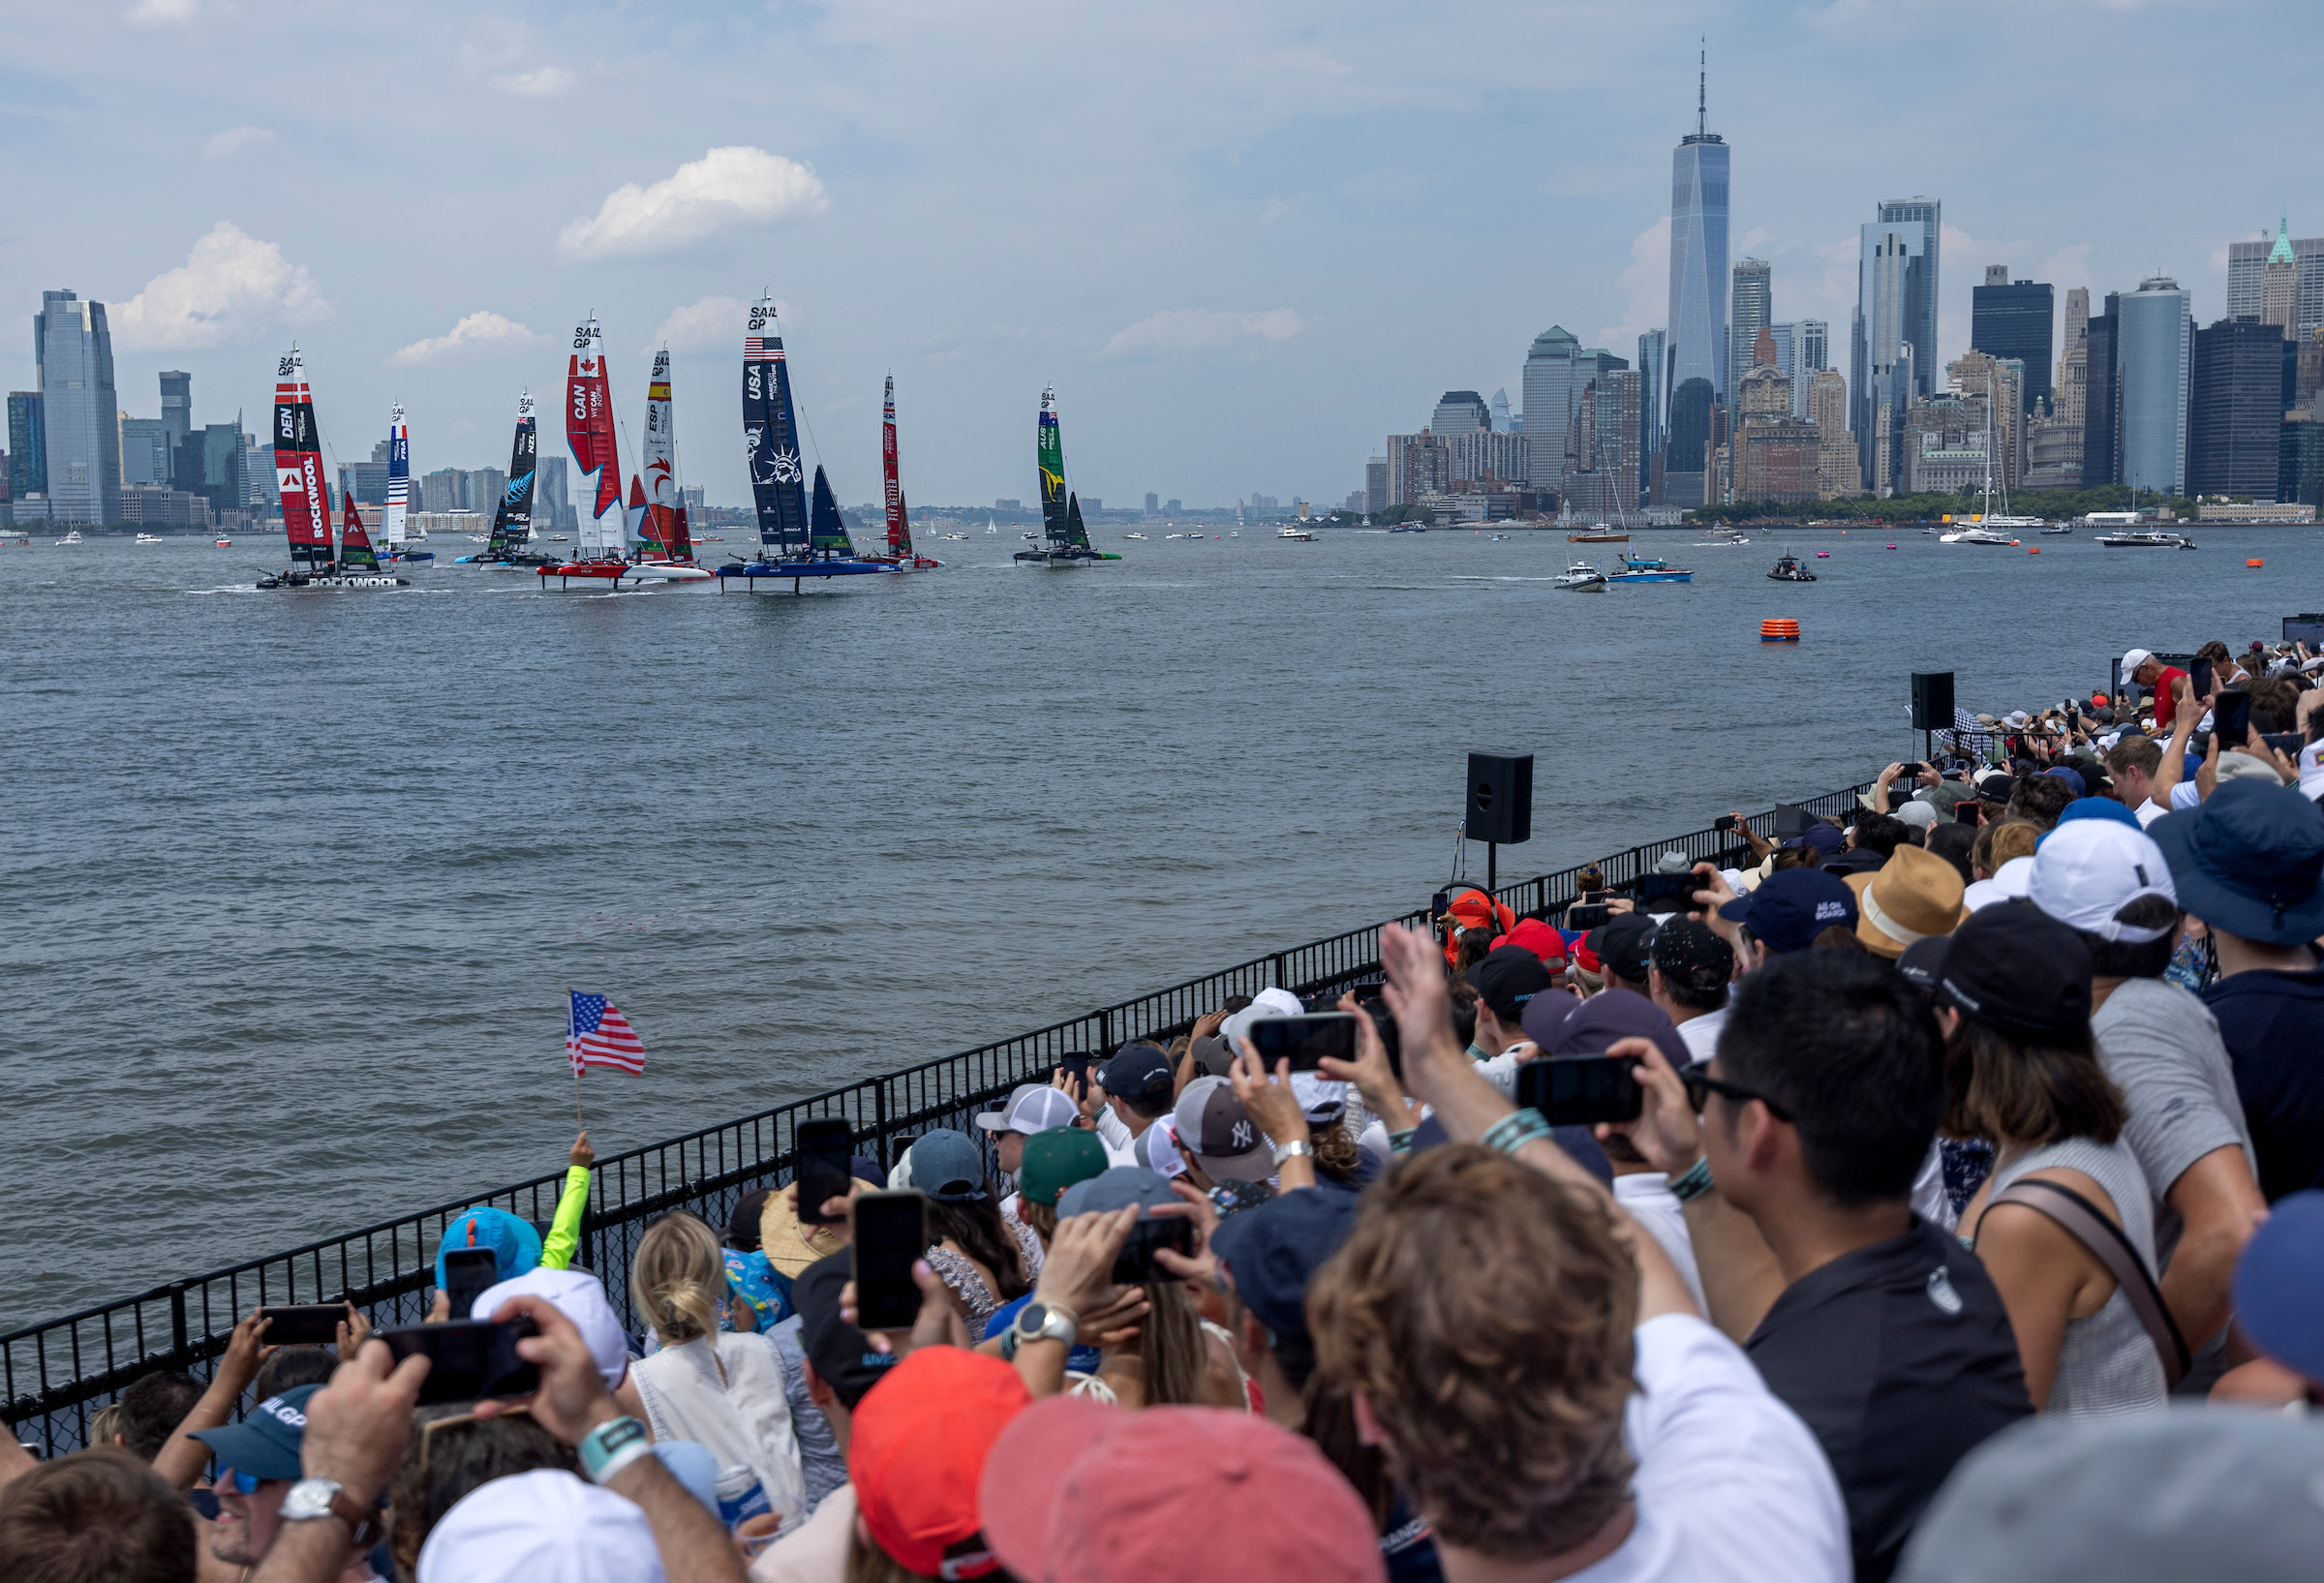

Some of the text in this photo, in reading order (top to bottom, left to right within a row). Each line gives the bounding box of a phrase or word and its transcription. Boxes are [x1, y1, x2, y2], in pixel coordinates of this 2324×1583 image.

[749, 306, 778, 318] SAIL
[748, 319, 766, 330] GP
[574, 326, 601, 338] SAIL
[573, 338, 591, 349] GP
[279, 356, 303, 367] SAIL
[654, 356, 669, 366] SAIL
[278, 366, 294, 377] GP
[652, 367, 664, 377] GP
[748, 364, 761, 401] USA
[573, 384, 587, 419] CAN
[1041, 392, 1055, 401] SAIL
[519, 398, 535, 407] SAIL
[592, 407, 597, 418] WE
[649, 404, 657, 432] ESP
[280, 407, 294, 440] DEN
[303, 456, 324, 538] ROCKWOOL
[889, 478, 899, 521] FLY BETTER
[1231, 1119, 1254, 1148] NY
